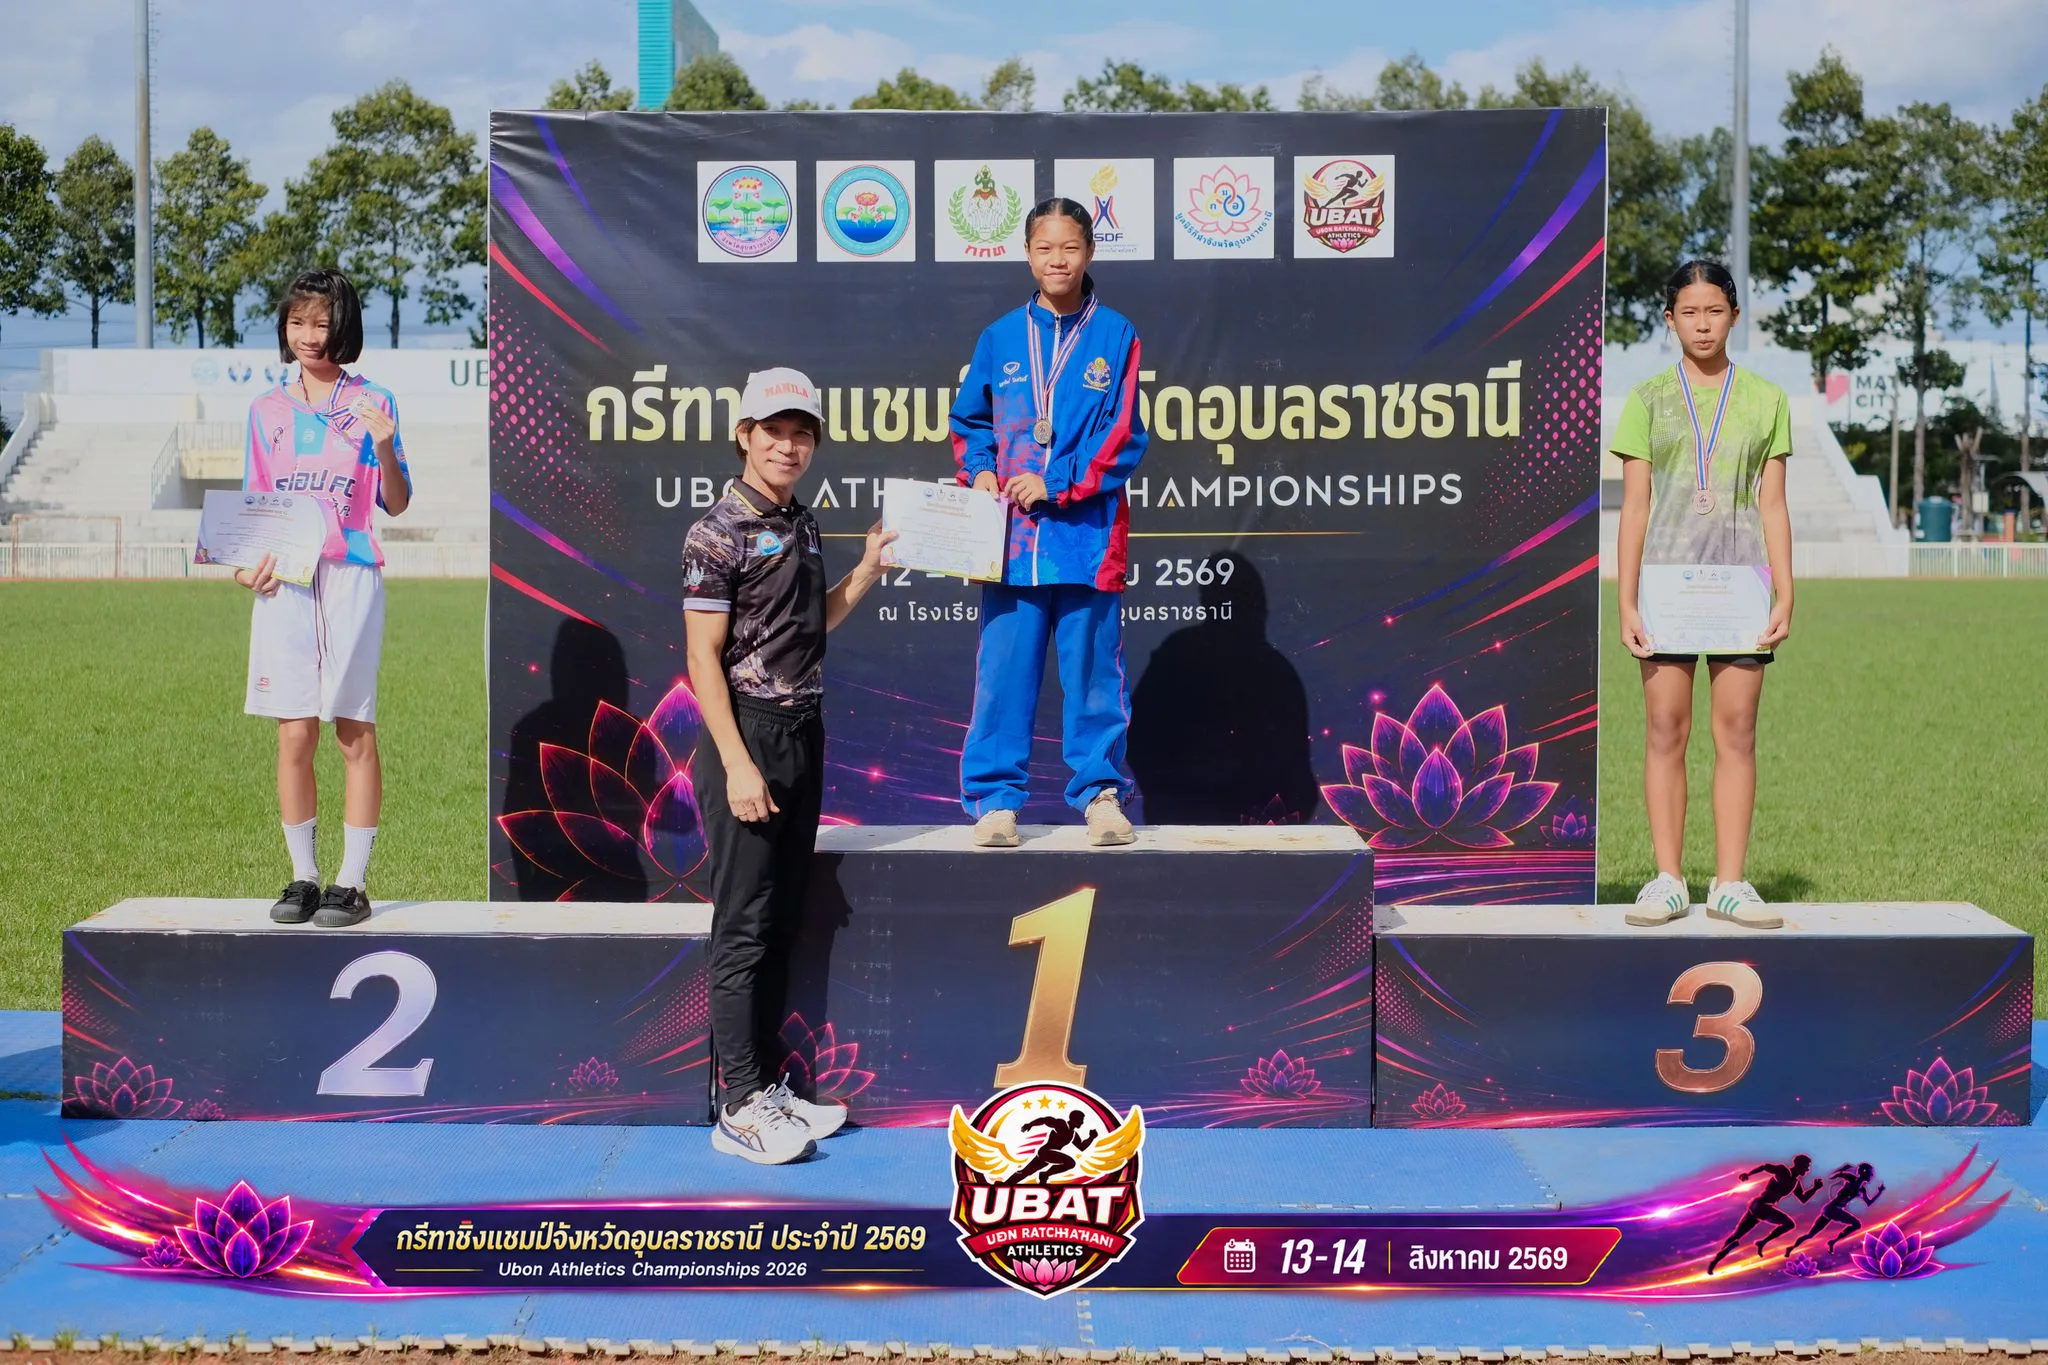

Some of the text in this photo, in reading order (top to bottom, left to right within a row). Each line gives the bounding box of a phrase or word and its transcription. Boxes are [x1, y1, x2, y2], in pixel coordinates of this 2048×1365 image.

[1310, 208, 1379, 226] UBAT
[1093, 233, 1124, 242] SDF
[764, 382, 809, 398] MANILA
[1125, 474, 1463, 508] HAMPIONSHIPS
[1155, 558, 1235, 586] 2569
[879, 601, 979, 621] ณ โรงเรีย
[993, 888, 1096, 1088] 1
[316, 951, 438, 1097] 2
[1655, 961, 1763, 1093] 3
